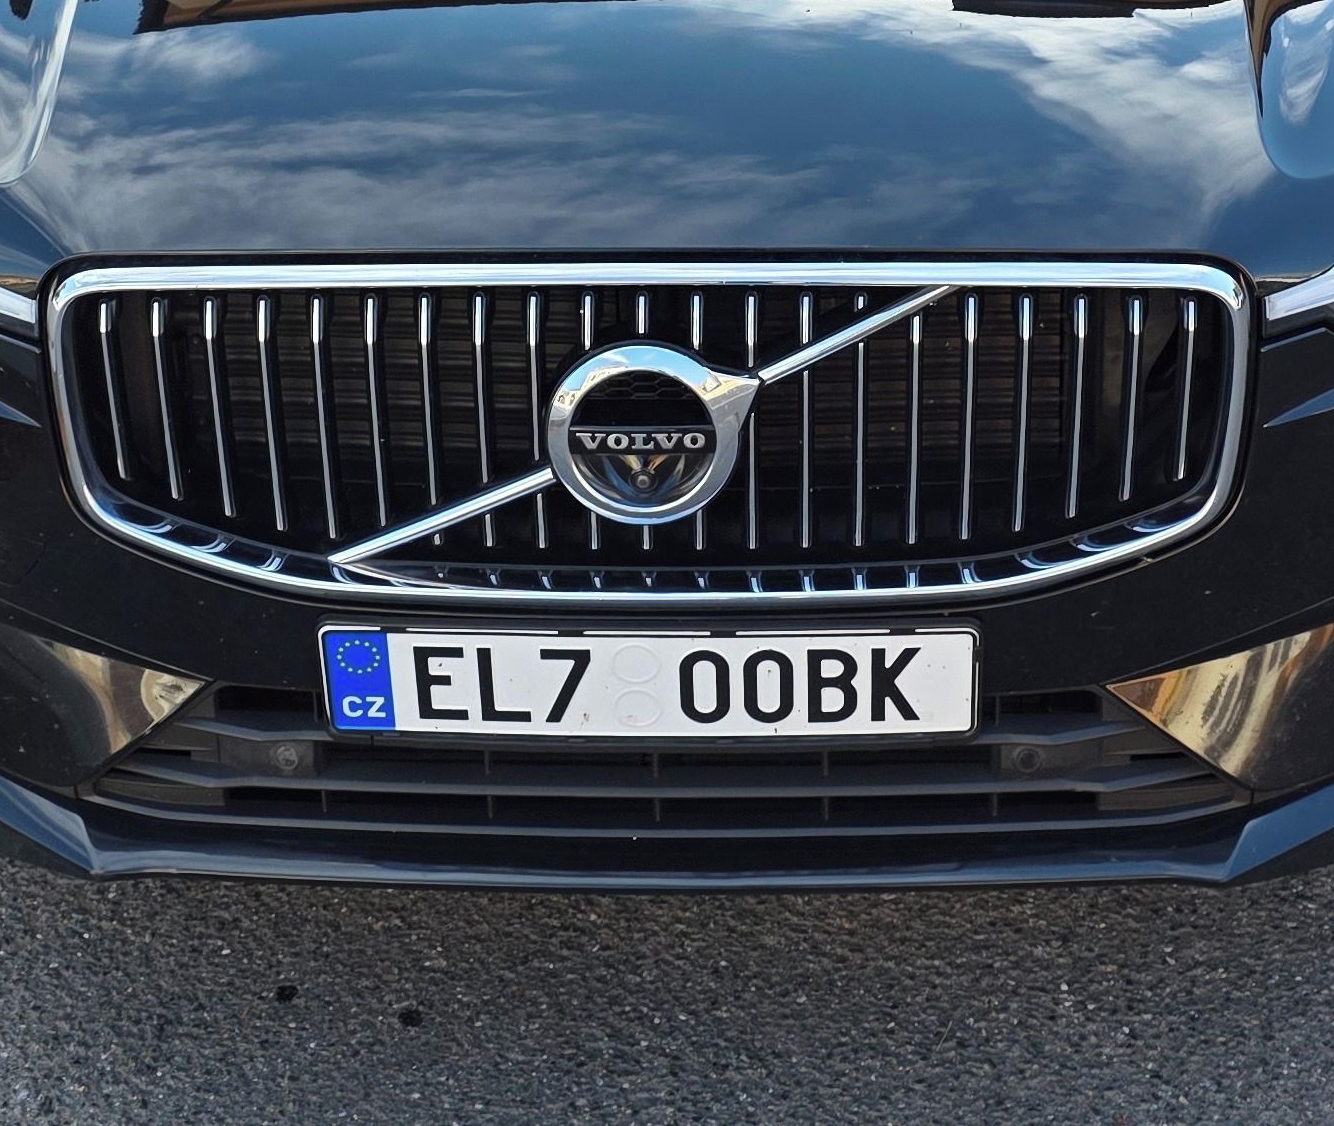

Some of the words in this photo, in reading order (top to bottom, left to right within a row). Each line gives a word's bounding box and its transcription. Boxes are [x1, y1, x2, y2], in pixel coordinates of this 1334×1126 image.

[575, 432, 706, 450] VOLVO
[411, 645, 592, 723] EL7
[677, 647, 923, 724] 00BK
[342, 695, 387, 718] CZ
